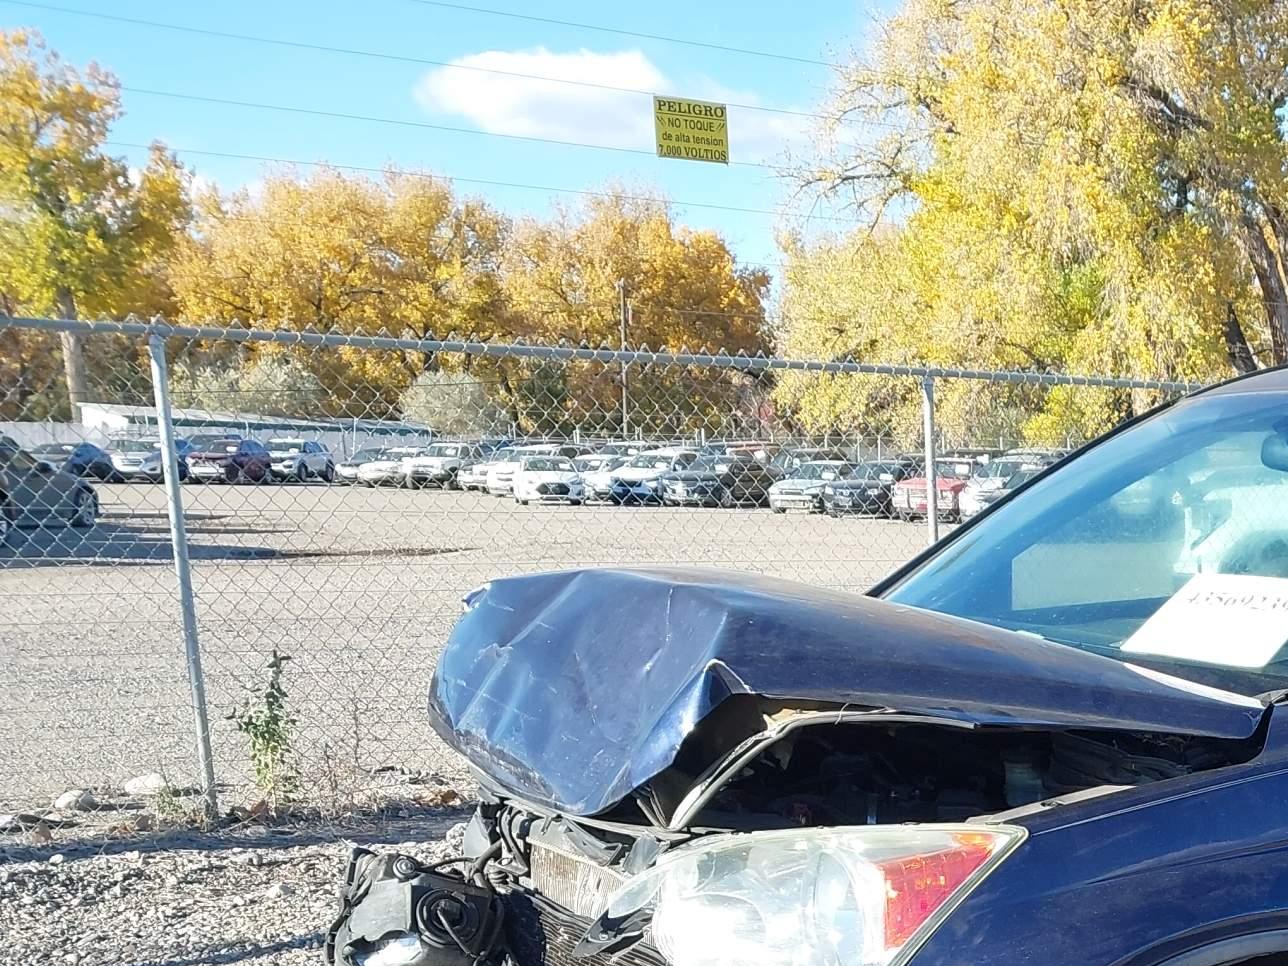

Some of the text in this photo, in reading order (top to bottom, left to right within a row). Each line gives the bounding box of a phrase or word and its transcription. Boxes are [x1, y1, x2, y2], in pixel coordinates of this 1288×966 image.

[656, 99, 724, 118] PELIGRO
[668, 117, 714, 132] NO TOQUE
[662, 131, 723, 147] de alta tension
[684, 147, 727, 161] VOLTIOS
